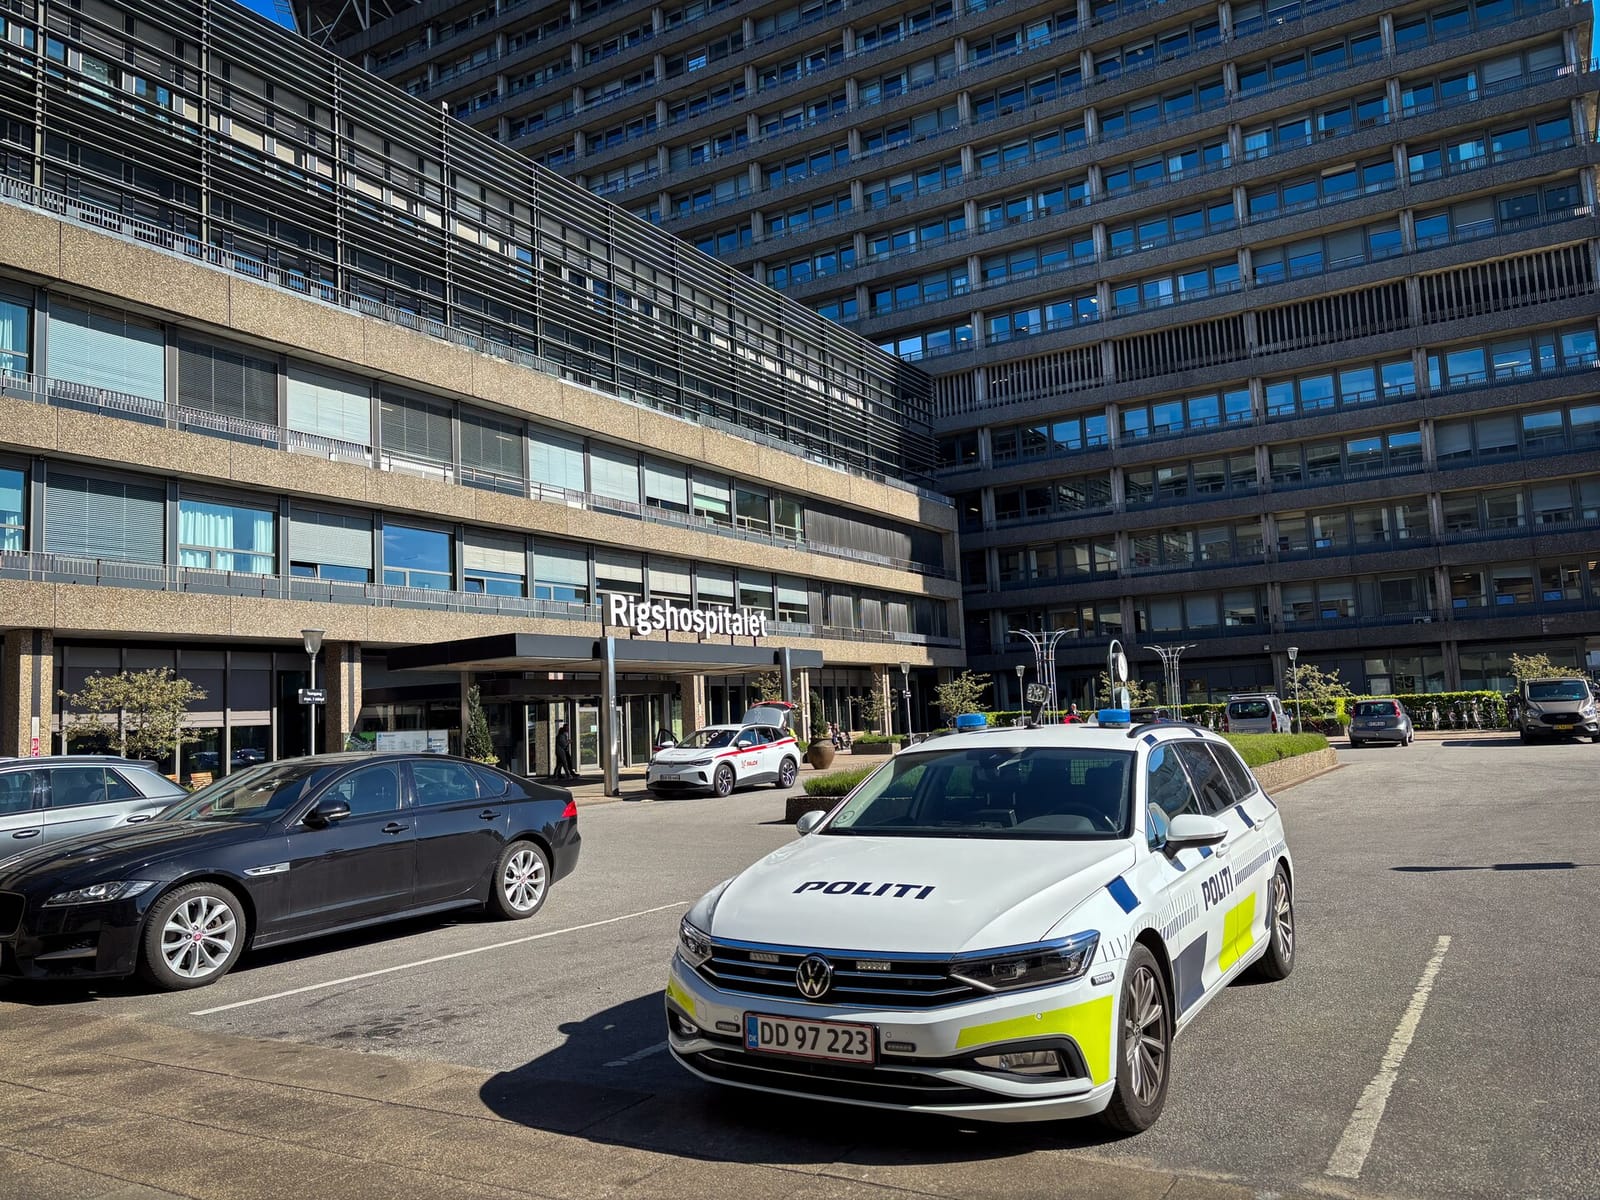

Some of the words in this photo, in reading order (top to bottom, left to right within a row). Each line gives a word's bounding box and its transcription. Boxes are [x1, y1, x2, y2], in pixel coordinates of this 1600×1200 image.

[609, 593, 768, 639] Rigshospitalet
[792, 881, 936, 900] POLITI
[1201, 865, 1234, 912] POLITI
[748, 1034, 758, 1042] DK
[760, 1021, 789, 1047] DD
[794, 1026, 820, 1050] 97
[826, 1028, 868, 1055] 223
